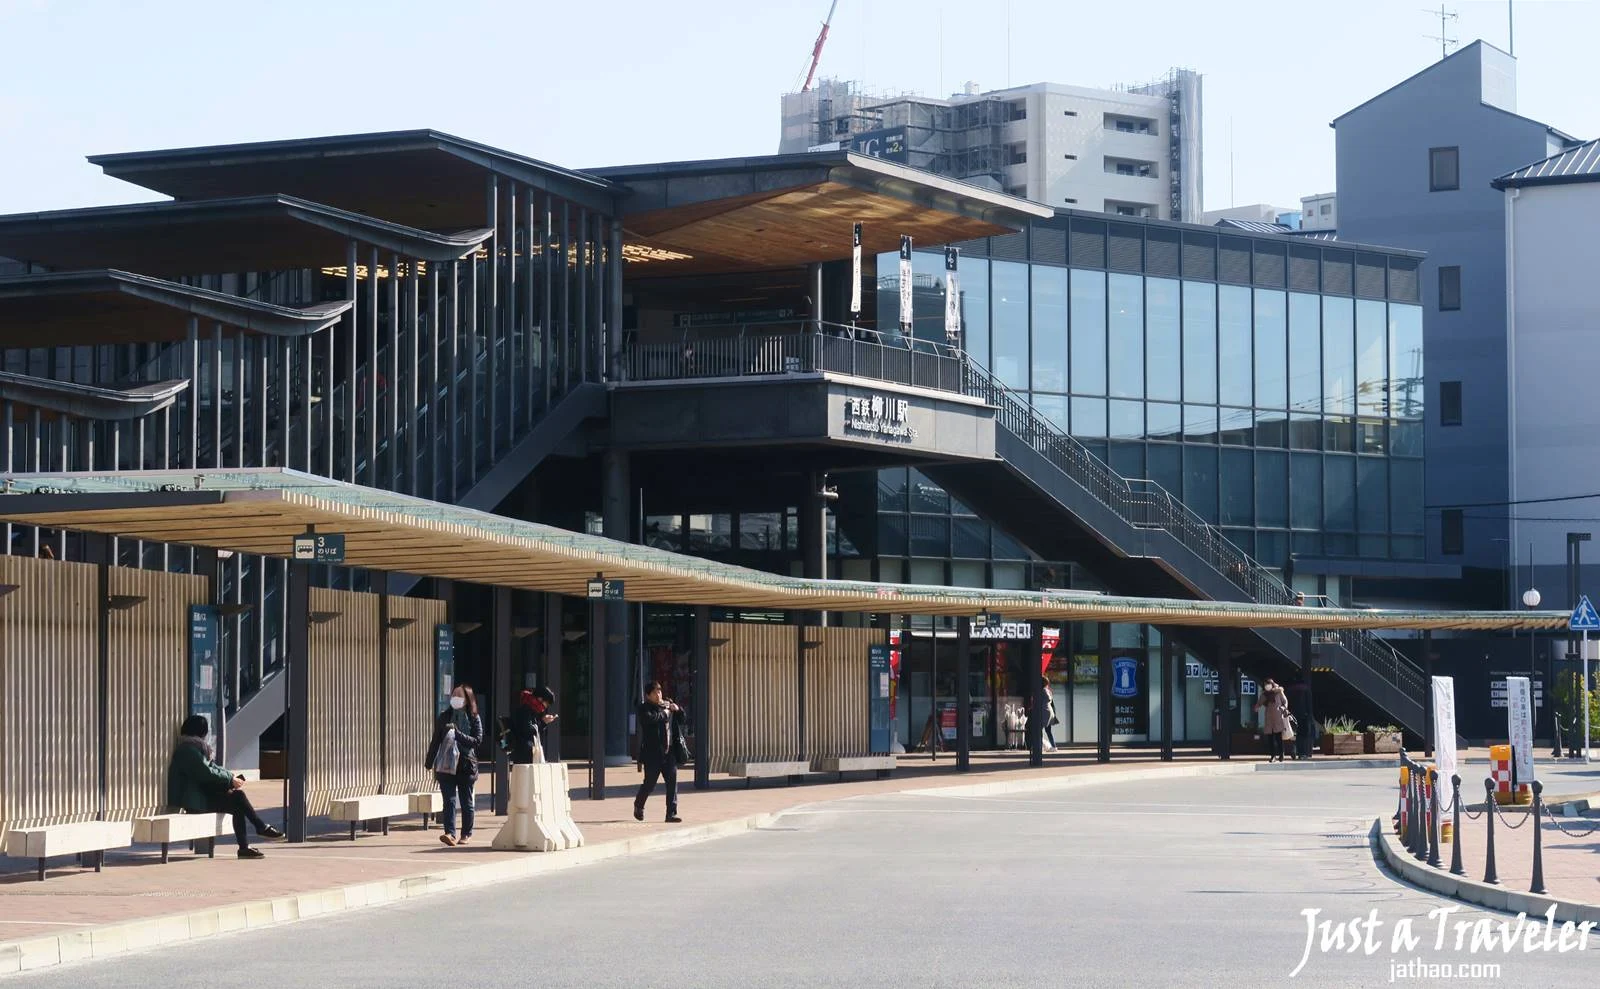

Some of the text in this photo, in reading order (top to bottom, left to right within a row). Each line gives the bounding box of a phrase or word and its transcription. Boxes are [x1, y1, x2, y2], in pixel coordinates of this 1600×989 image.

[851, 395, 909, 422] 西鉄柳川駅
[851, 418, 880, 433] Nishitetsu
[880, 423, 908, 437] Yanagawa
[317, 536, 325, 547] 3
[604, 581, 610, 589] 2
